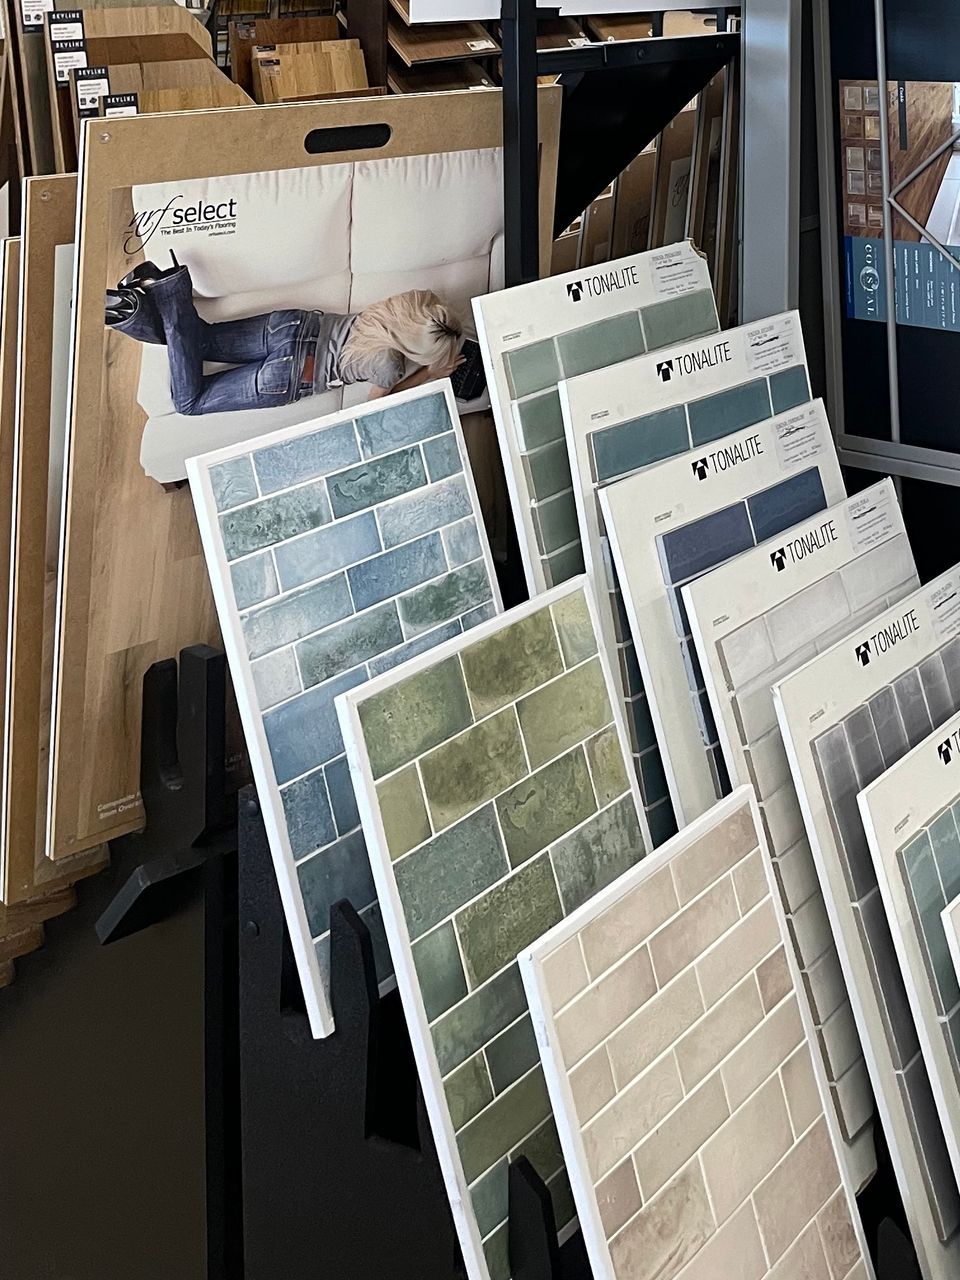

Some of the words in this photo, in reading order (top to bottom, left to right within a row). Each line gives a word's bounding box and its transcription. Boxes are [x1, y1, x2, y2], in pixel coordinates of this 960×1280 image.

[78, 68, 106, 76] SKYLINE
[172, 198, 237, 225] select
[172, 227, 185, 235] Best
[193, 223, 214, 232] Today's
[584, 265, 640, 298] TONALITE
[675, 341, 732, 377] TONALITE
[708, 434, 764, 474] TONALITE
[786, 520, 838, 565] TONALITE
[870, 609, 920, 657] TONALITE
